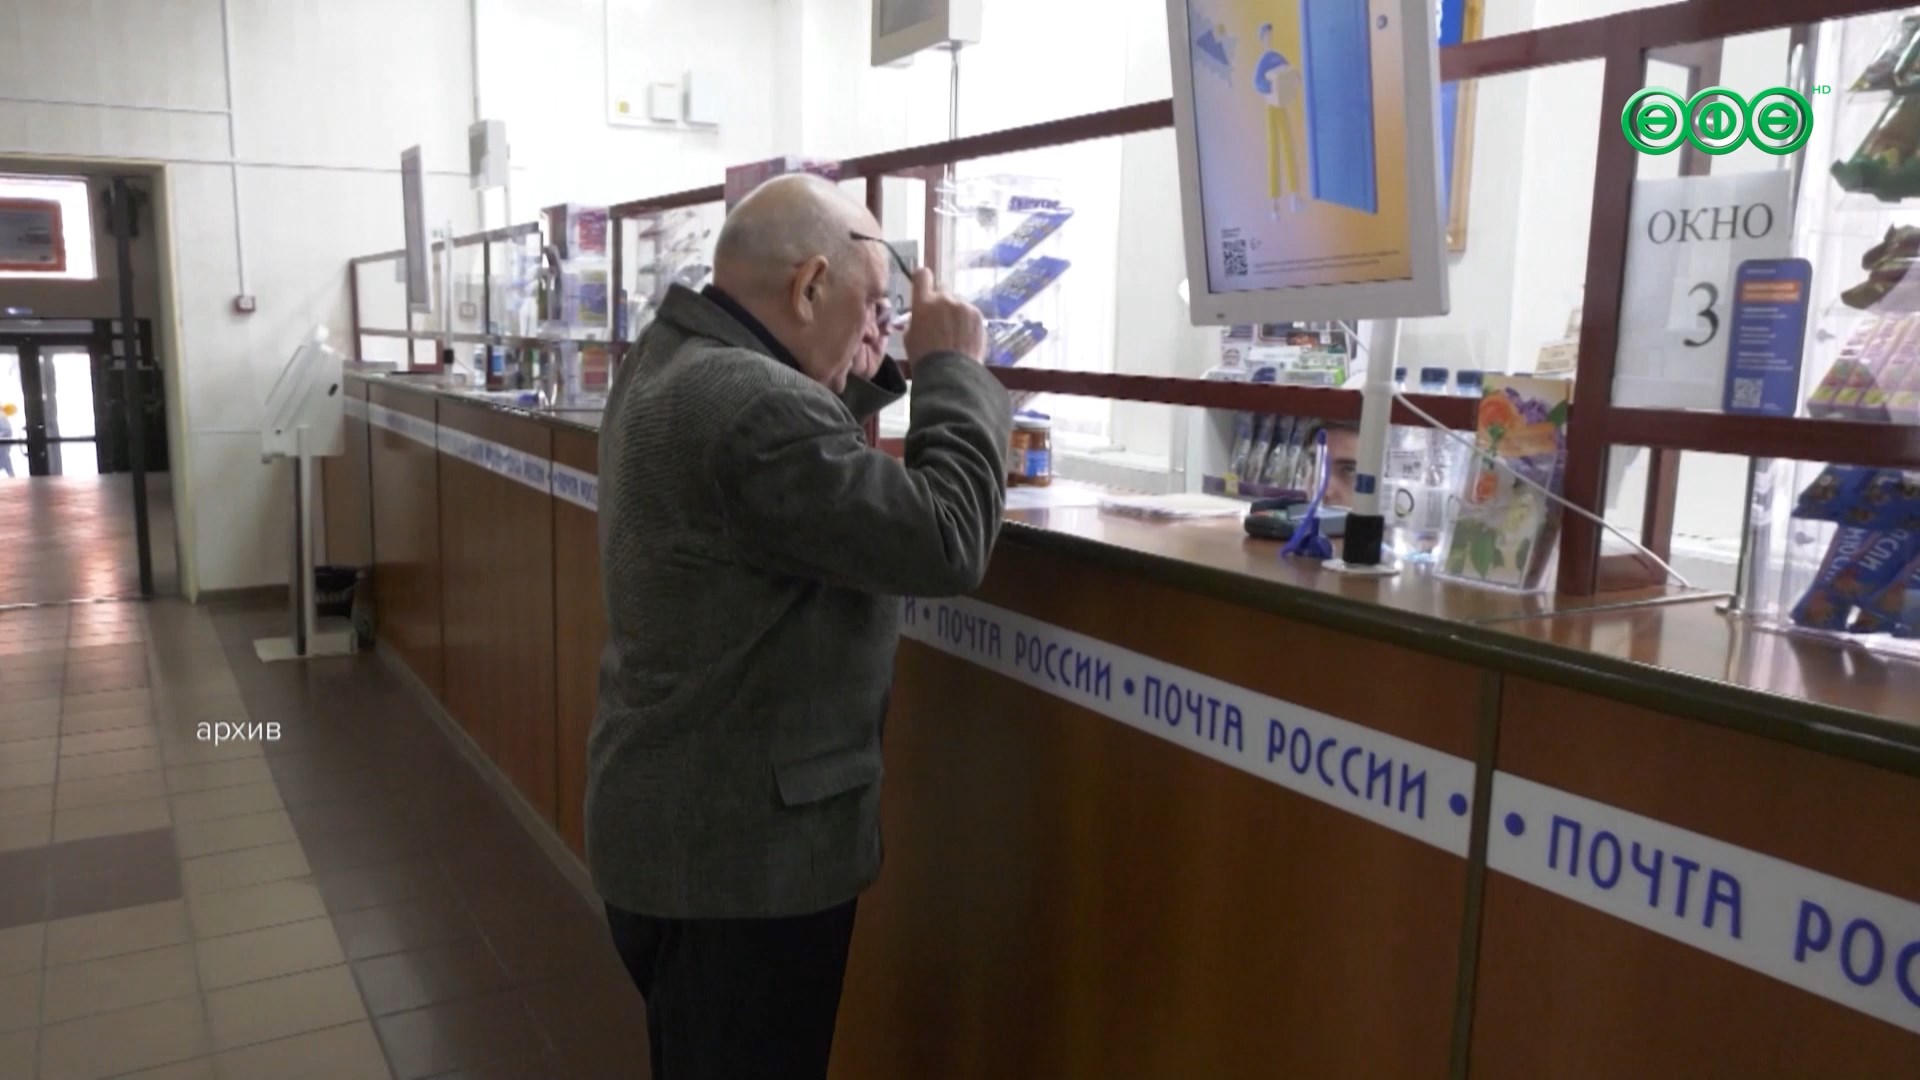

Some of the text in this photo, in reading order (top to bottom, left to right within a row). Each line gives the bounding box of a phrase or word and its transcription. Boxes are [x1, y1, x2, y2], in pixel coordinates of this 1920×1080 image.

[1647, 202, 1774, 245] ОКНО
[1683, 281, 1720, 348] 3
[937, 605, 1001, 660] ПОЧТА
[1015, 630, 1112, 701] РОССИИ
[1143, 675, 1244, 752] ПОЧТА
[1267, 718, 1427, 821] РОССИИ
[1548, 814, 1742, 940] ПОЧТА
